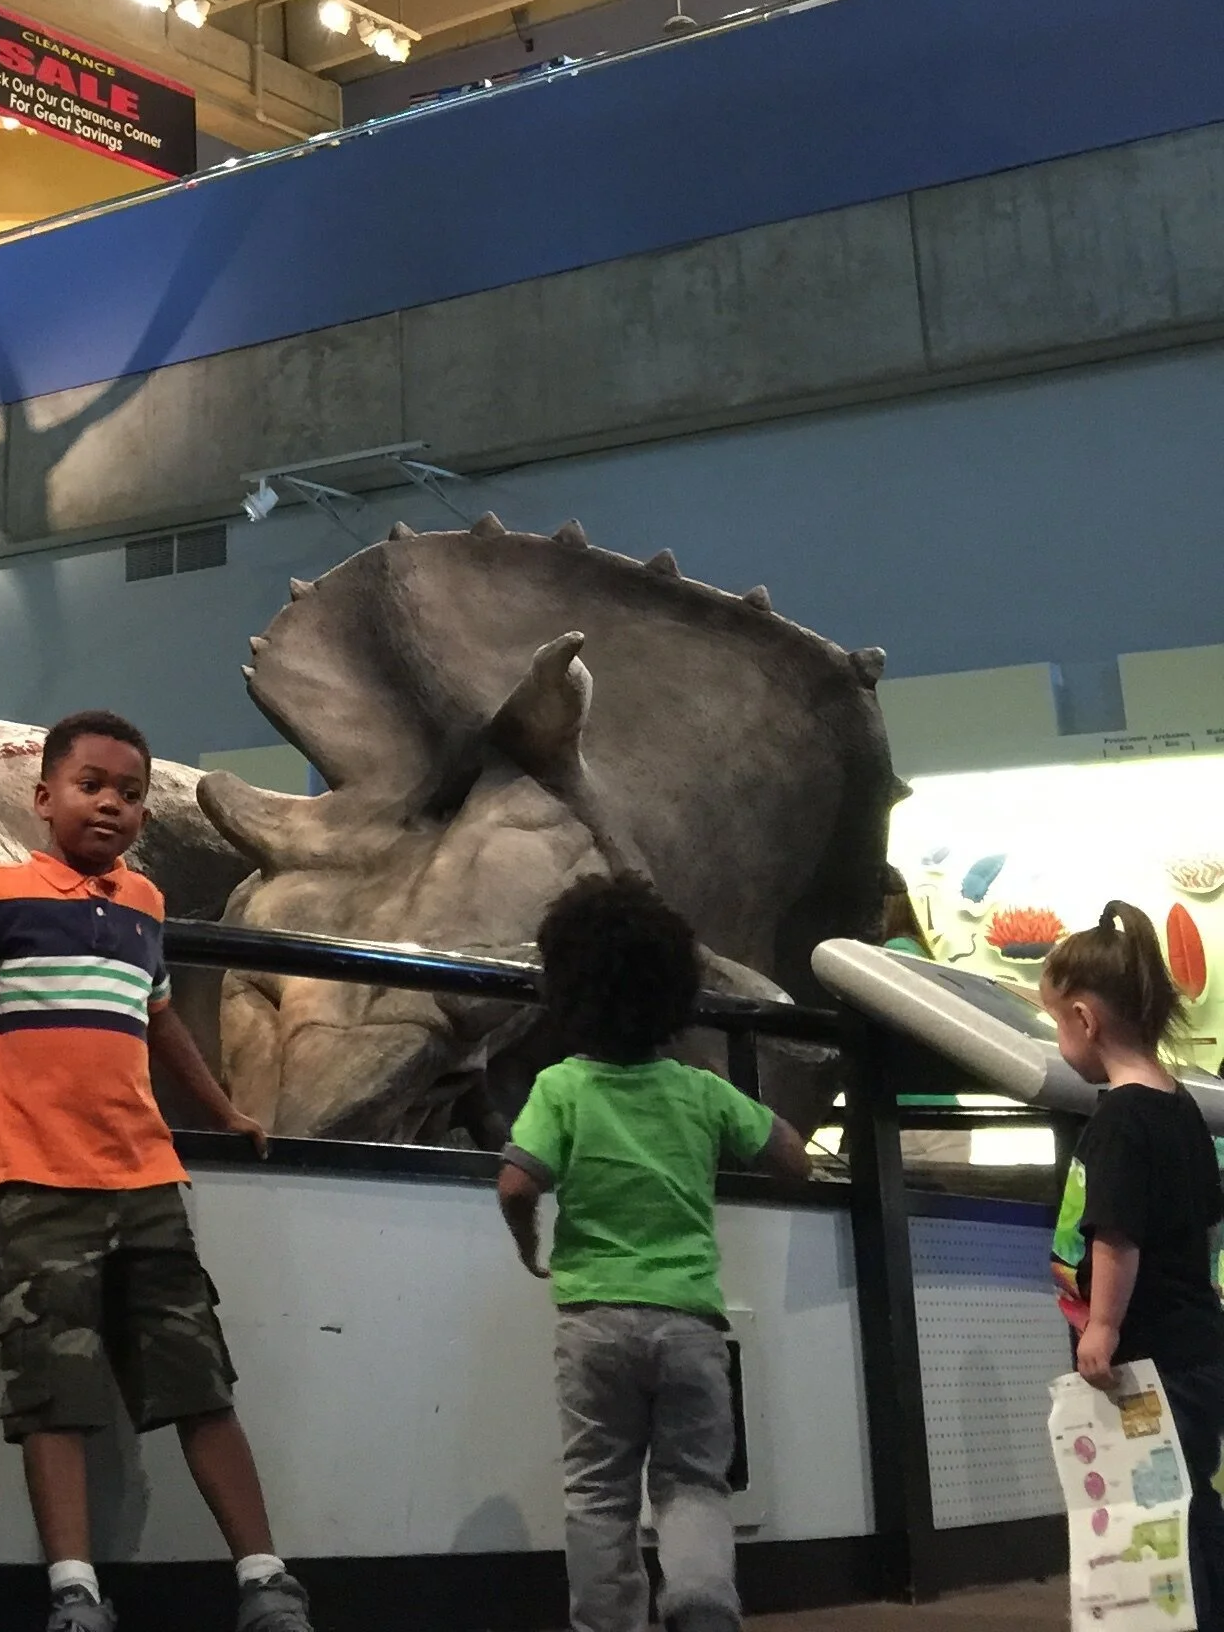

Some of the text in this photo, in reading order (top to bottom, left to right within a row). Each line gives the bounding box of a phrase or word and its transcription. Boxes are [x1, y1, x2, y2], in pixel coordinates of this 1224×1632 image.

[22, 31, 116, 77] CLEARANCE
[9, 93, 123, 152] For Great Savings
[12, 77, 34, 98] Out
[36, 87, 58, 107] Our
[60, 97, 122, 133] Clearance
[123, 122, 162, 148] Corner
